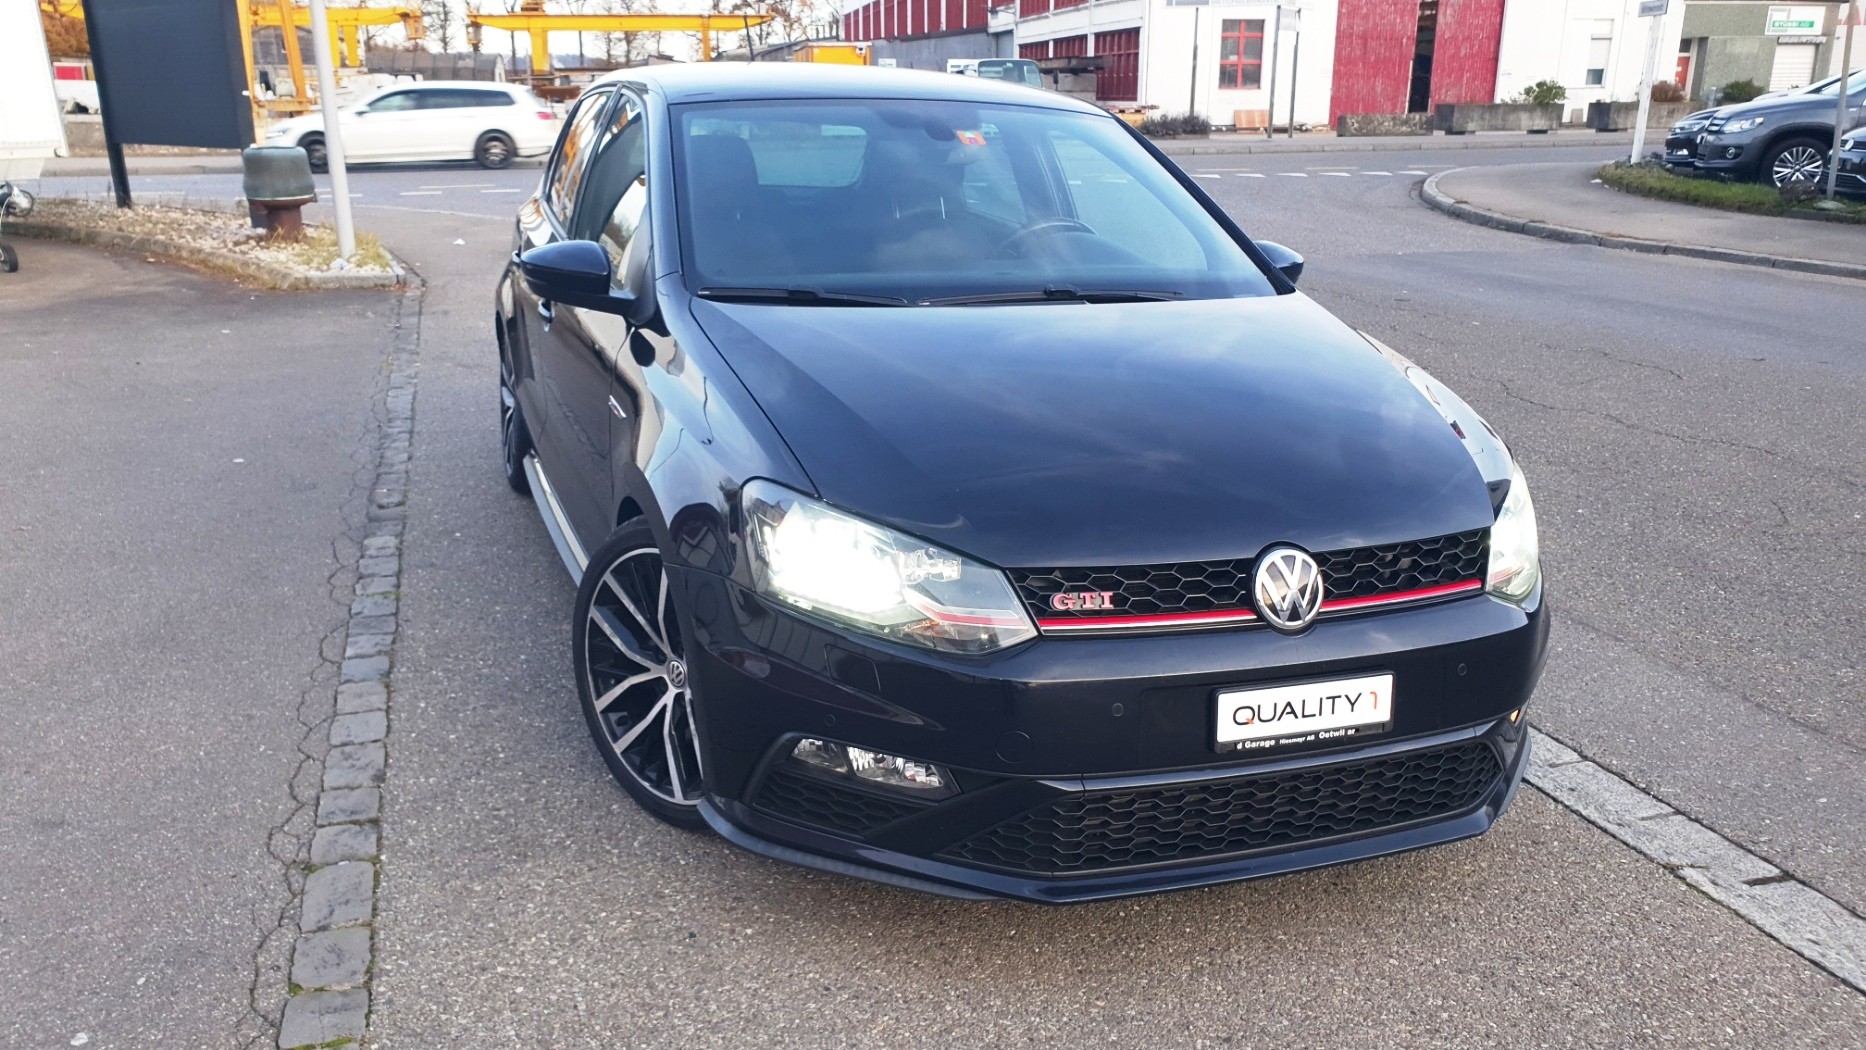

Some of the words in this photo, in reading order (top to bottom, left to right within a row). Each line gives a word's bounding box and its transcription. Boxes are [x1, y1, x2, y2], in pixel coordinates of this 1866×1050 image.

[1051, 592, 1114, 610] GTI
[1254, 548, 1323, 628] VW
[1233, 693, 1362, 726] QUALITY
[1244, 739, 1276, 749] Garage
[1319, 728, 1345, 739] Oetwil
